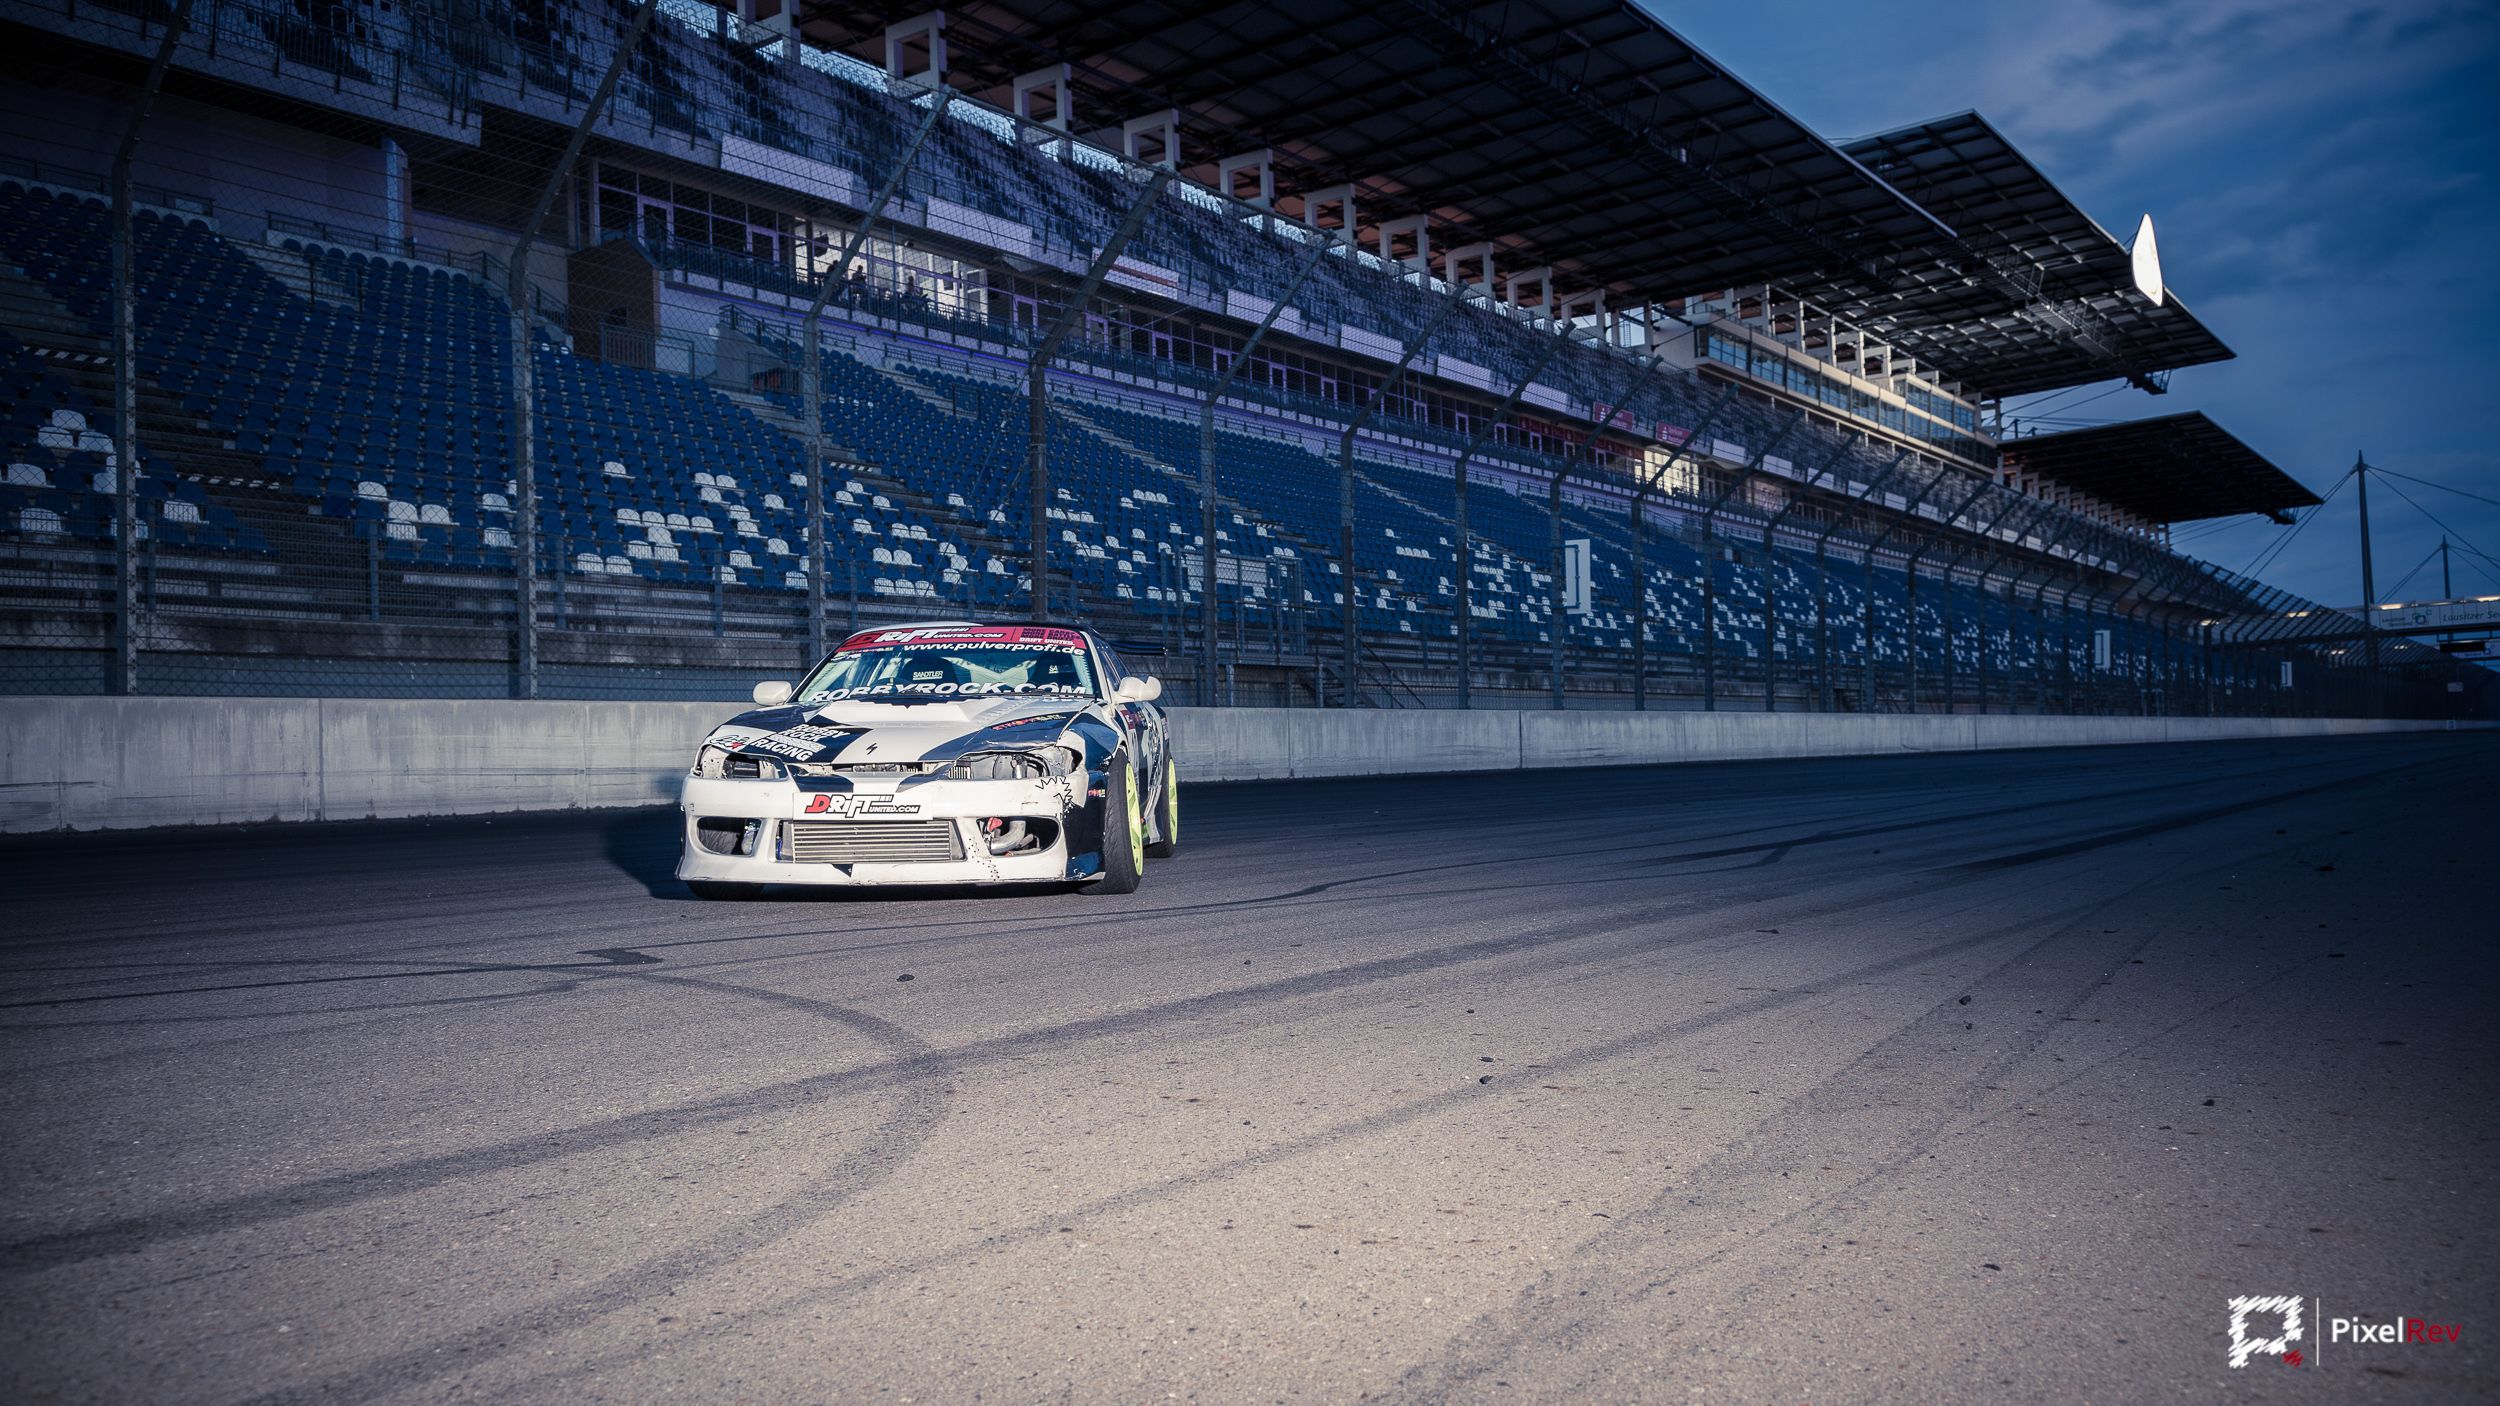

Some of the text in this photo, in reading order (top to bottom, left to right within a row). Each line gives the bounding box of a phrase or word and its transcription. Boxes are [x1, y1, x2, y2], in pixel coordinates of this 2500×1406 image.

[904, 641, 1085, 656] www.pulverprofi.de
[912, 671, 944, 680] SANDTLER
[778, 729, 828, 742] ROCK
[791, 724, 850, 738] ROBBY
[751, 739, 813, 761] RACING
[868, 804, 920, 813] UNITED.COM
